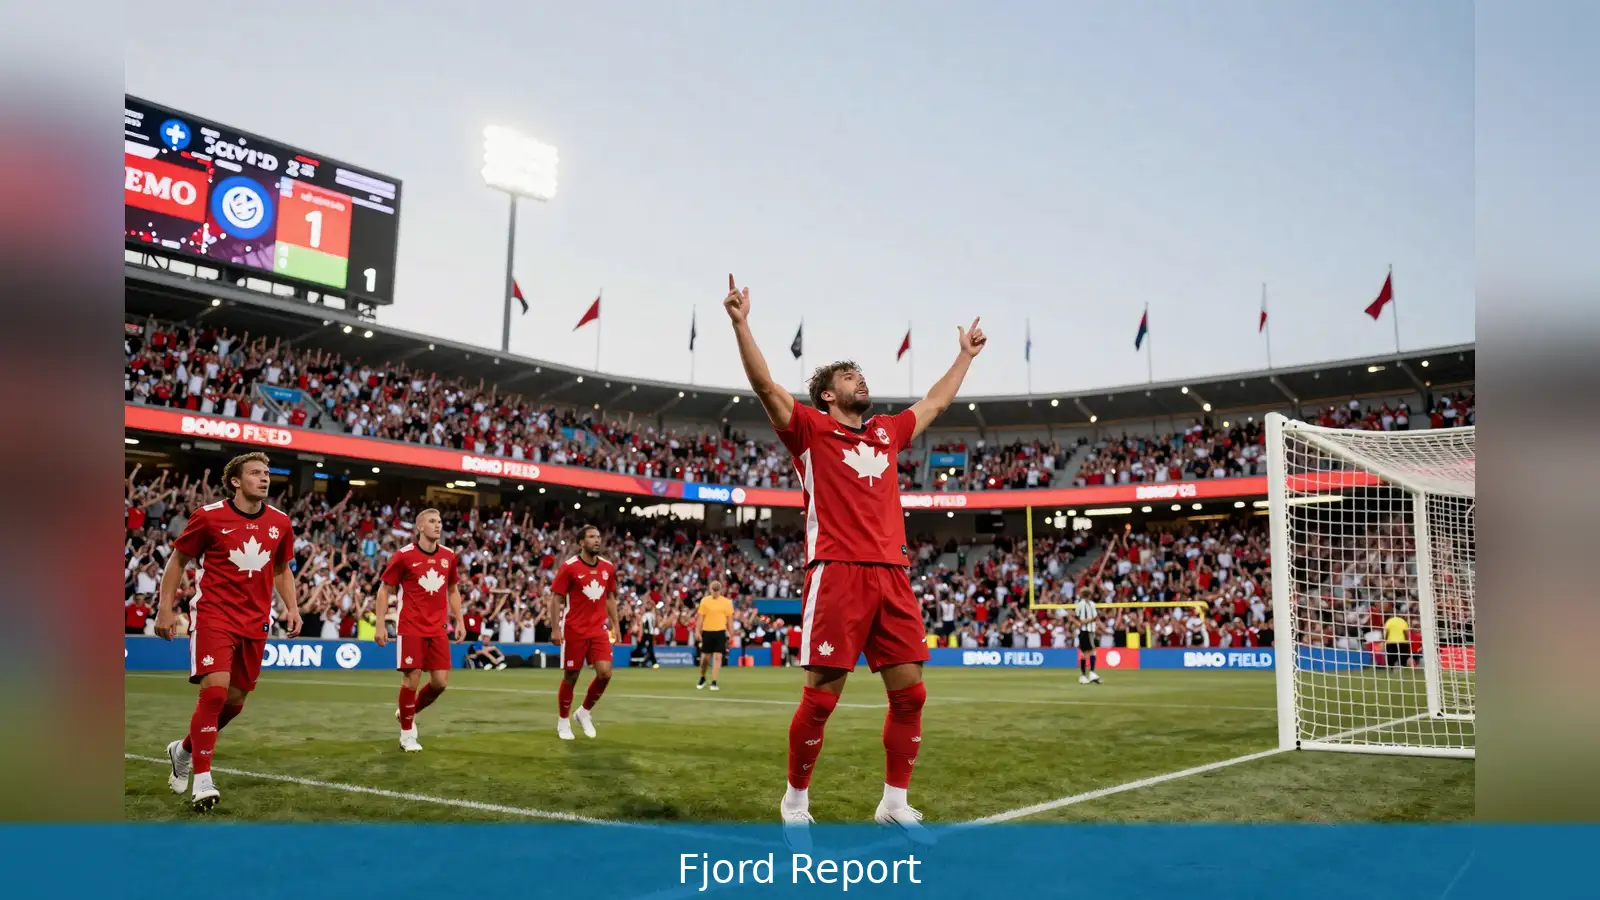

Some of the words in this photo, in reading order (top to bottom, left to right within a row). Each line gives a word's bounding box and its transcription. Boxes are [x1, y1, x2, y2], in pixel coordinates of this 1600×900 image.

[305, 210, 323, 248] 1
[363, 267, 377, 292] 1
[181, 416, 240, 439] BOMO
[1004, 652, 1044, 666] FIELD
[1183, 651, 1226, 667] BMO
[1228, 652, 1272, 667] FIELD
